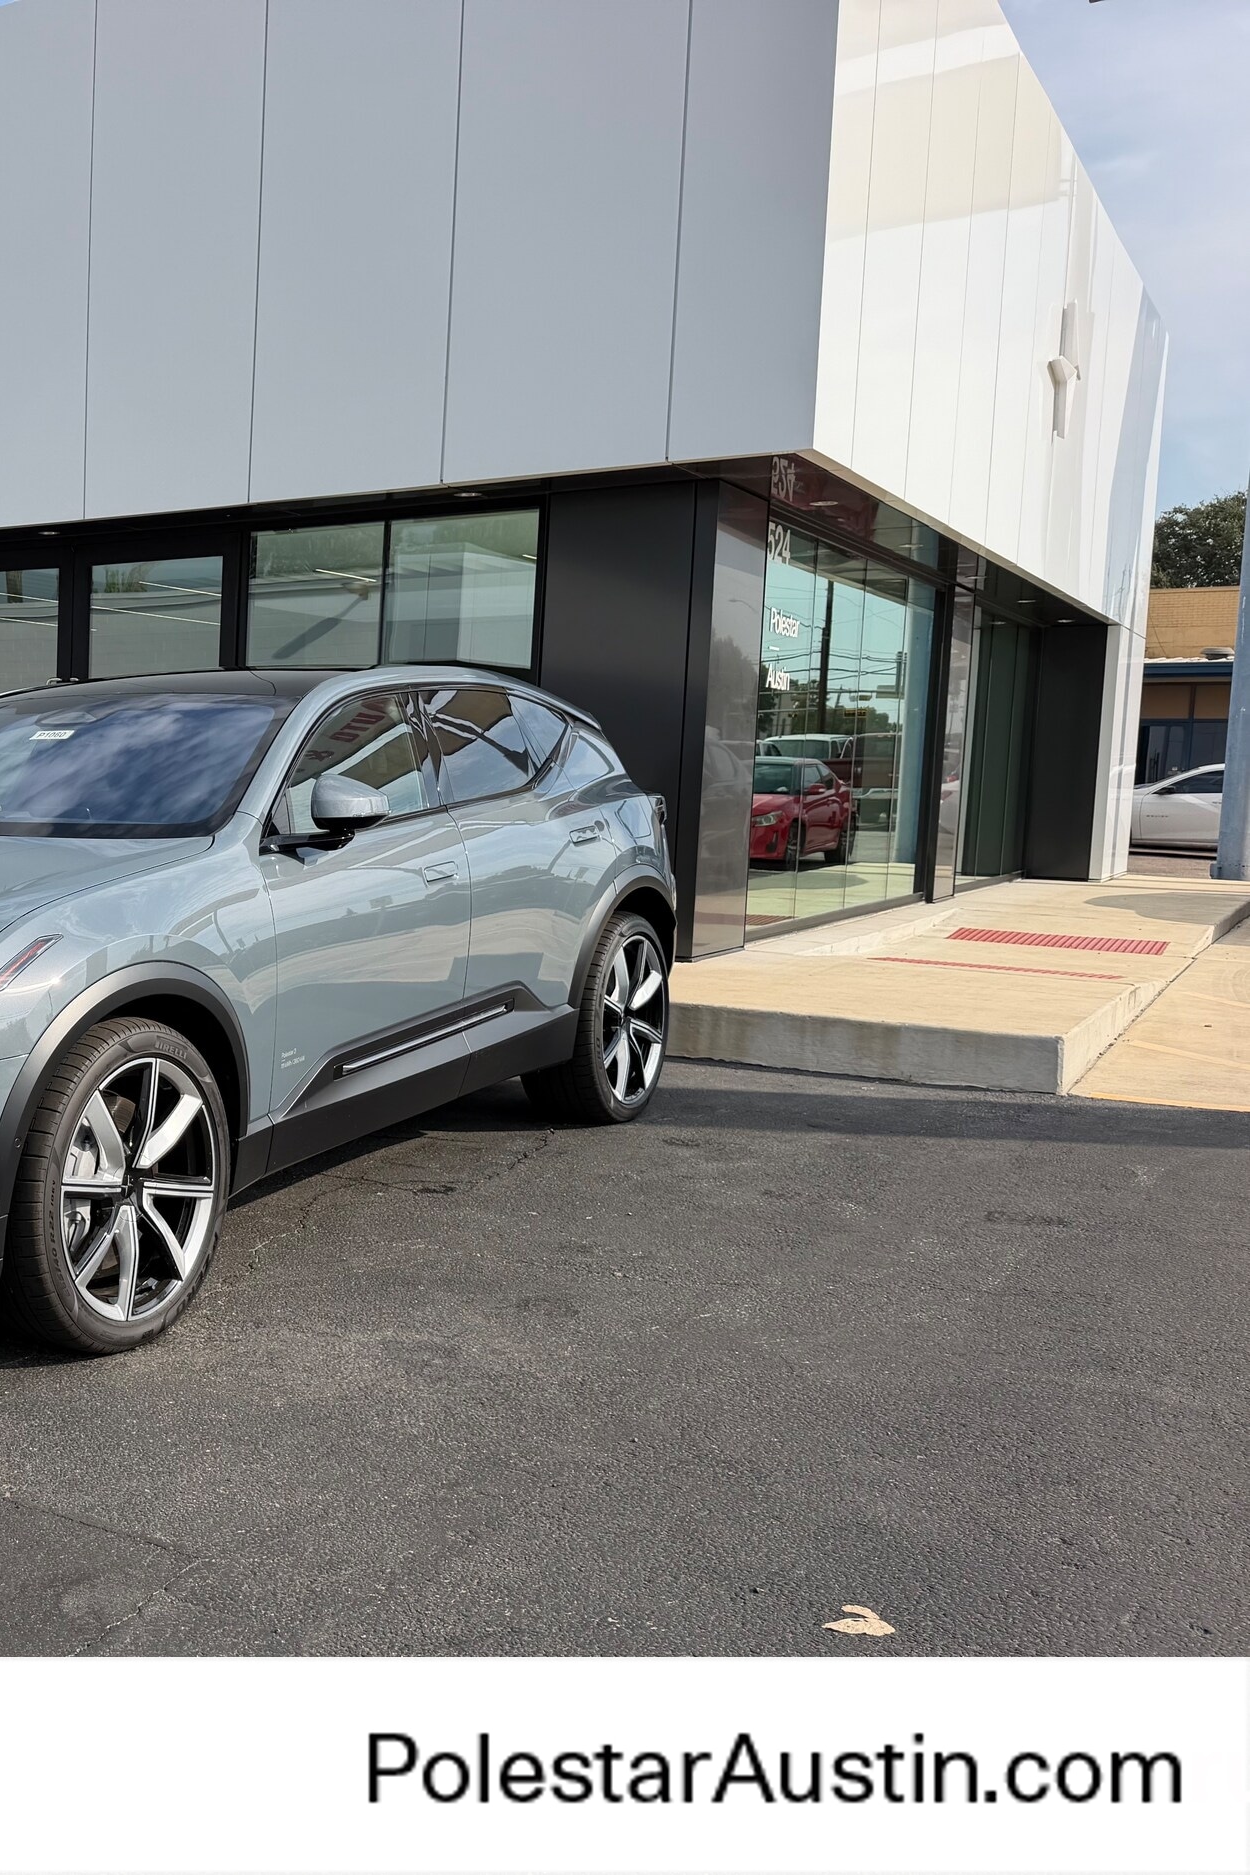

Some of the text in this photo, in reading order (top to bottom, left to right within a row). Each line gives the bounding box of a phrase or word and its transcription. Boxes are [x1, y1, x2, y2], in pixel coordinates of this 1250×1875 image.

[767, 521, 791, 566] 524
[770, 607, 800, 638] Polestar
[766, 663, 790, 691] Austin
[155, 1041, 187, 1060] PIRELLI
